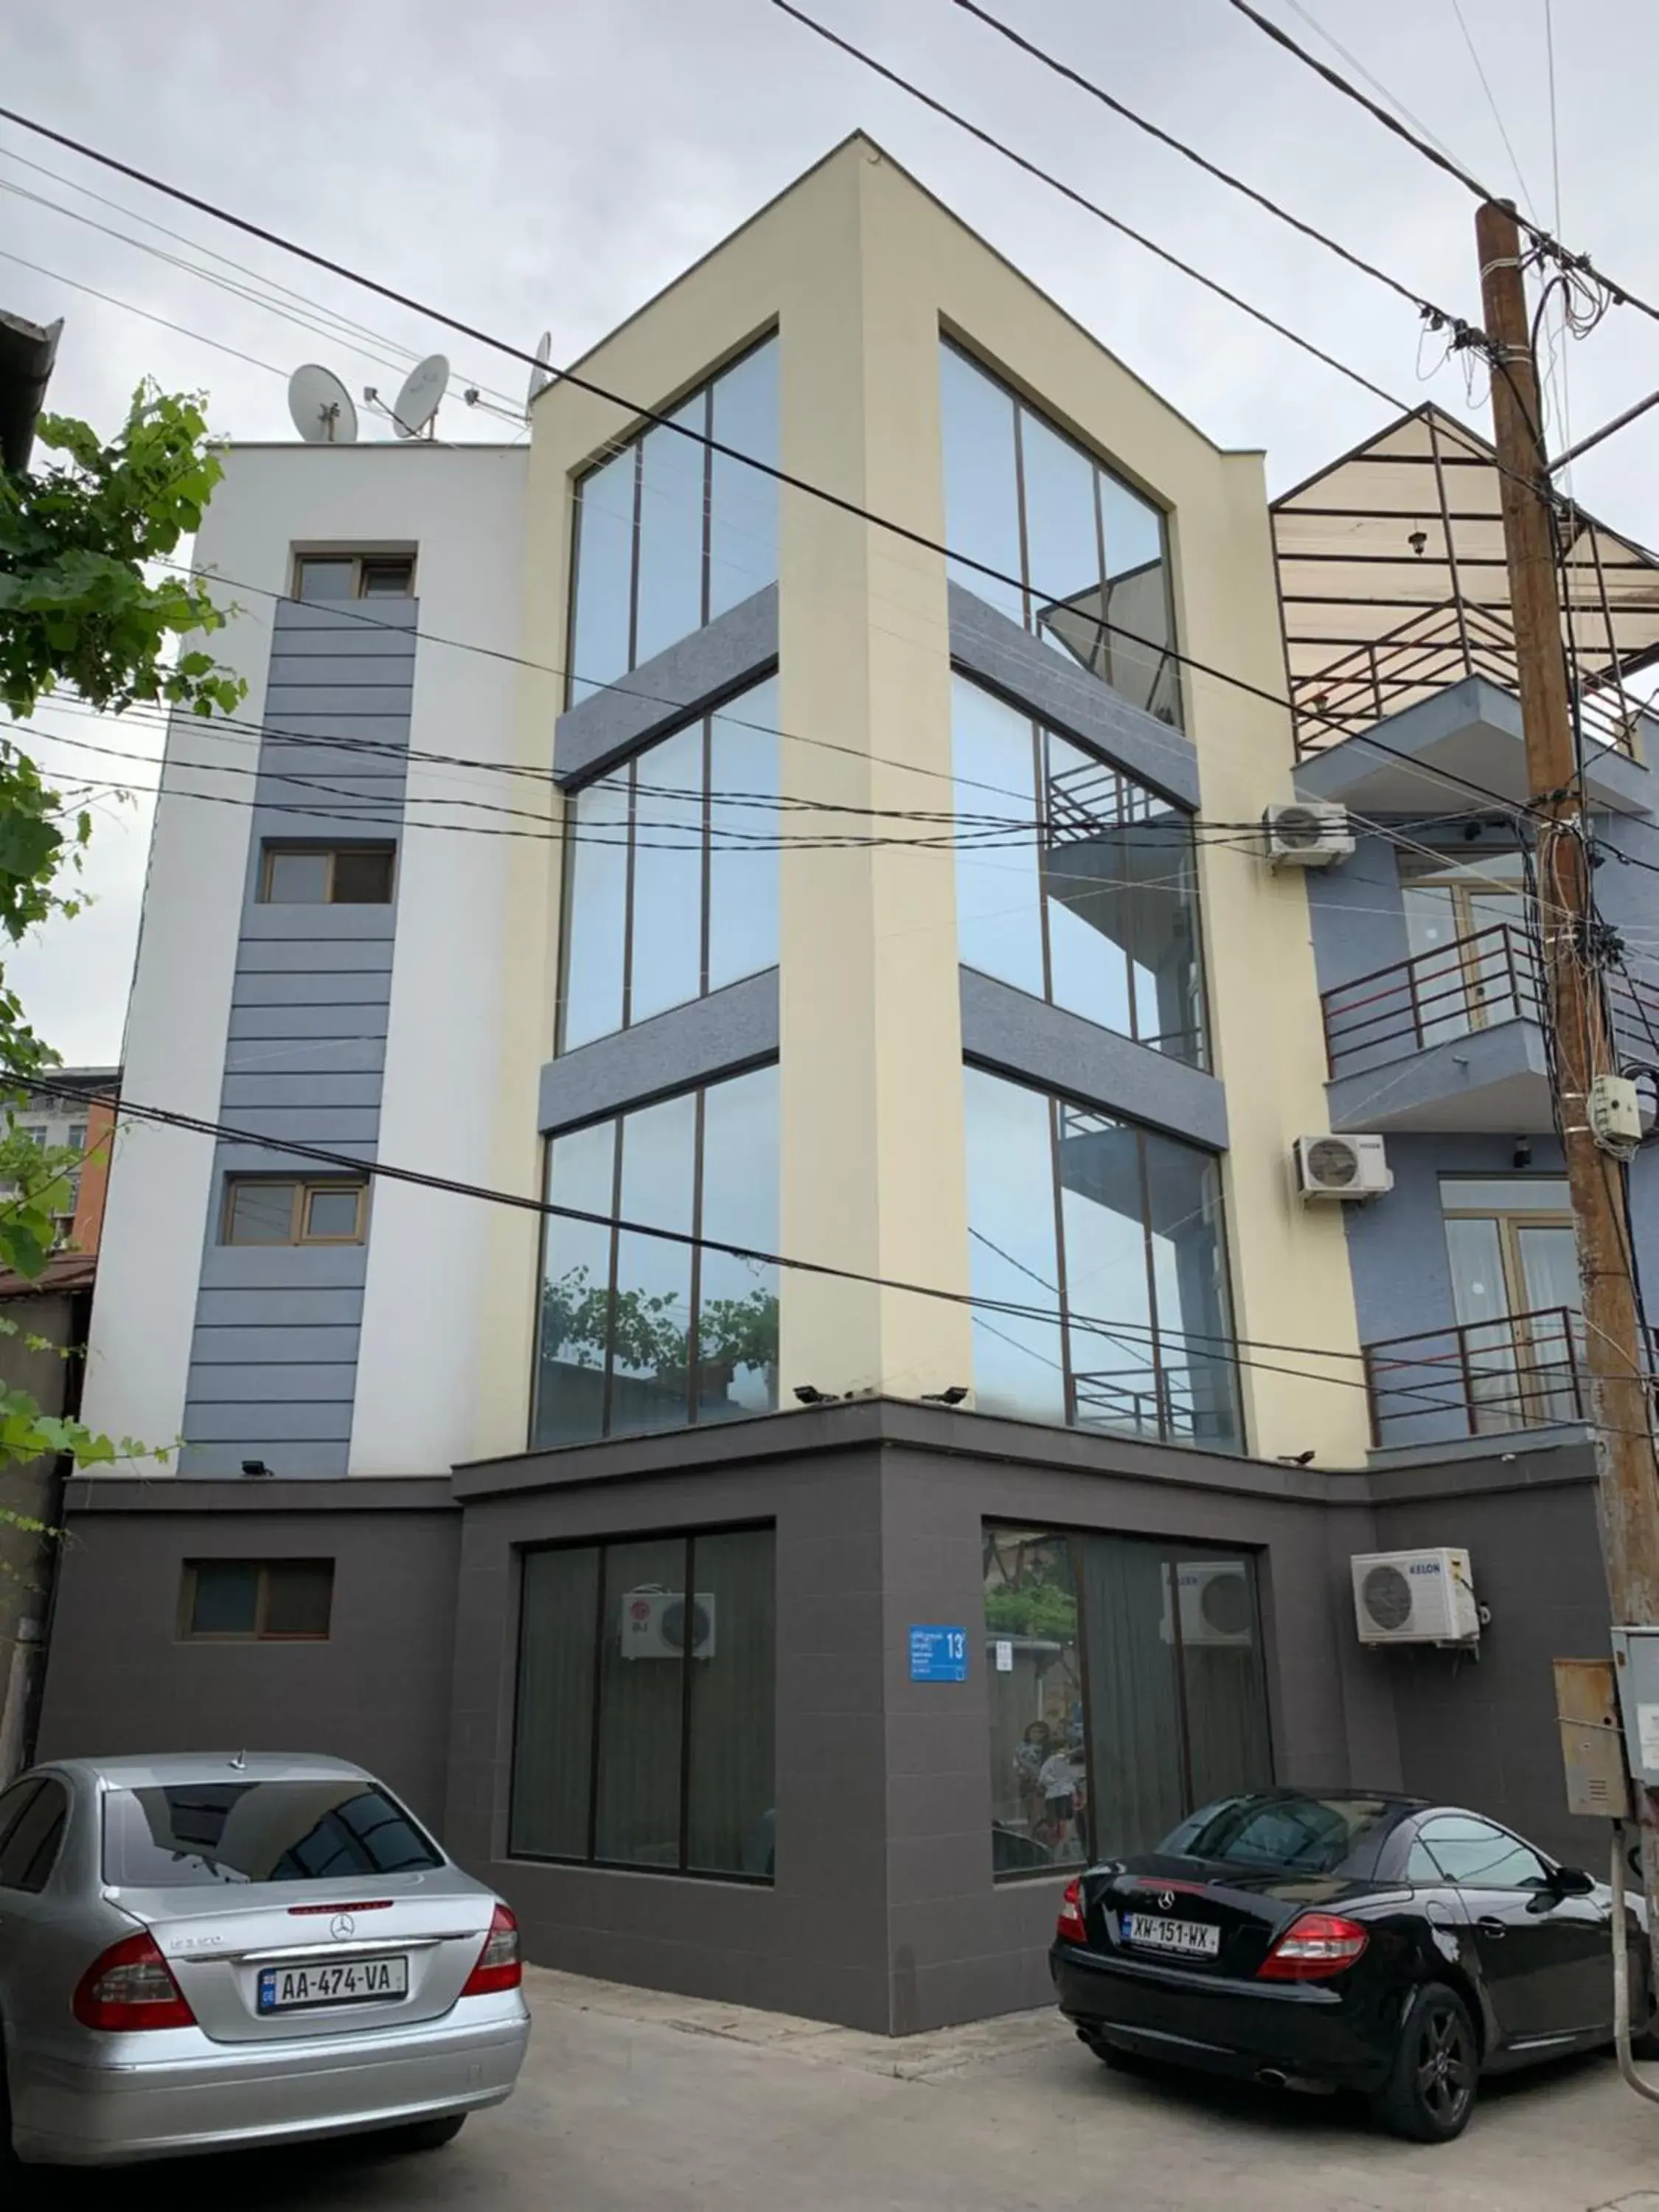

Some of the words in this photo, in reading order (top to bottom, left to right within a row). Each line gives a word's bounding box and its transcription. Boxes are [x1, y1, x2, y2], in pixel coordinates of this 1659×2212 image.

[1409, 1562, 1441, 1575] KELON
[947, 1633, 963, 1659] 13
[1135, 1916, 1208, 1948] XW-151-WX
[282, 1964, 391, 2000] AA-474-VA
